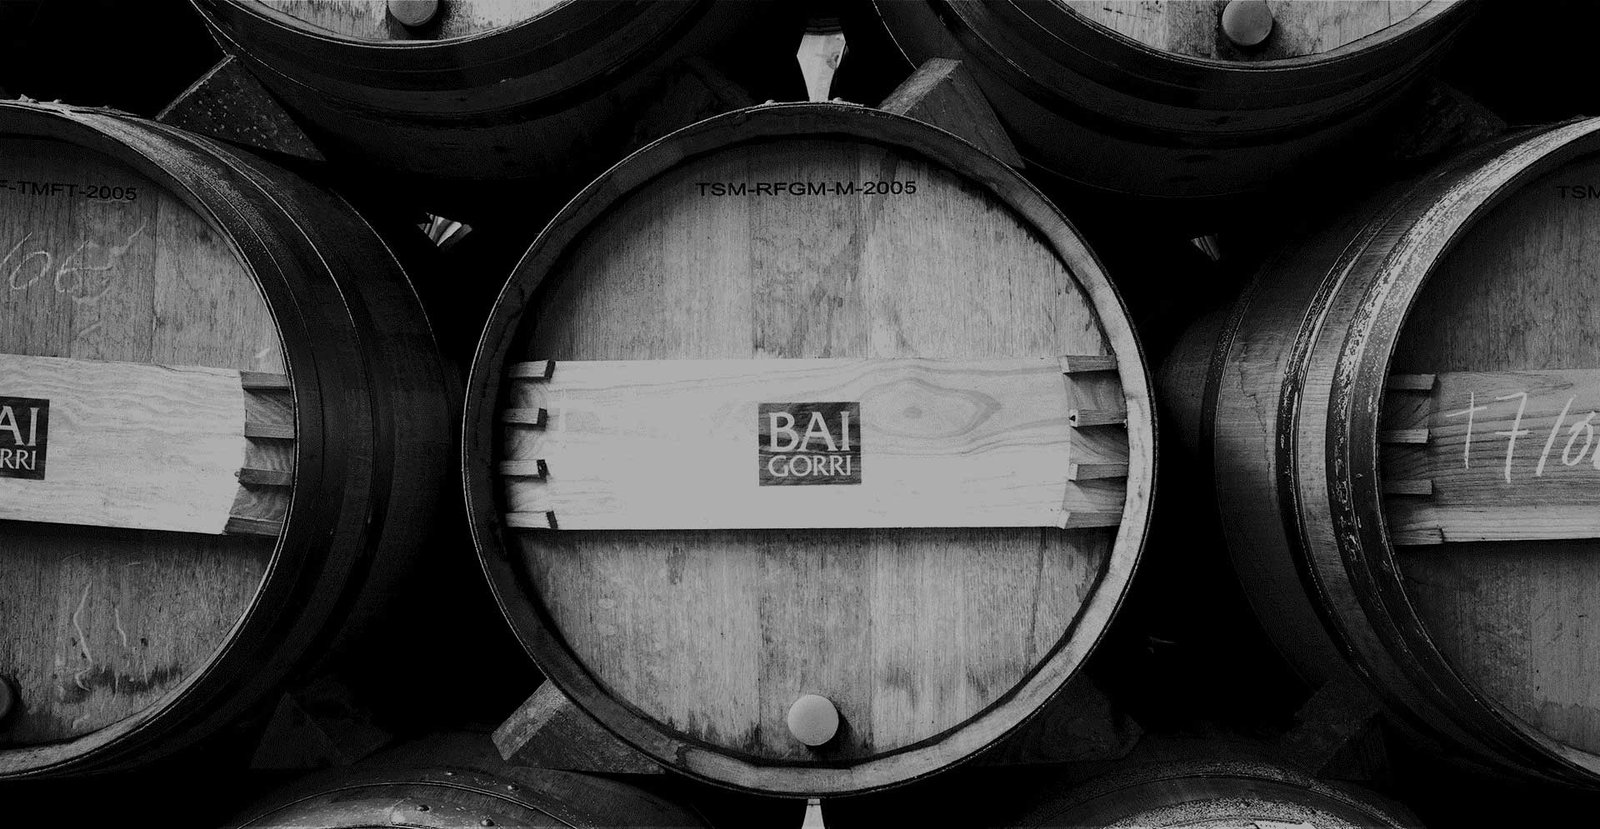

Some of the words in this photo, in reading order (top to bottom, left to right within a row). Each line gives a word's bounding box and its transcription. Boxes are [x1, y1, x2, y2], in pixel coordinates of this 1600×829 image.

[695, 180, 917, 197] TSM-RFGM-M-2005
[768, 410, 851, 452] BAI
[768, 454, 852, 477] GORRI
